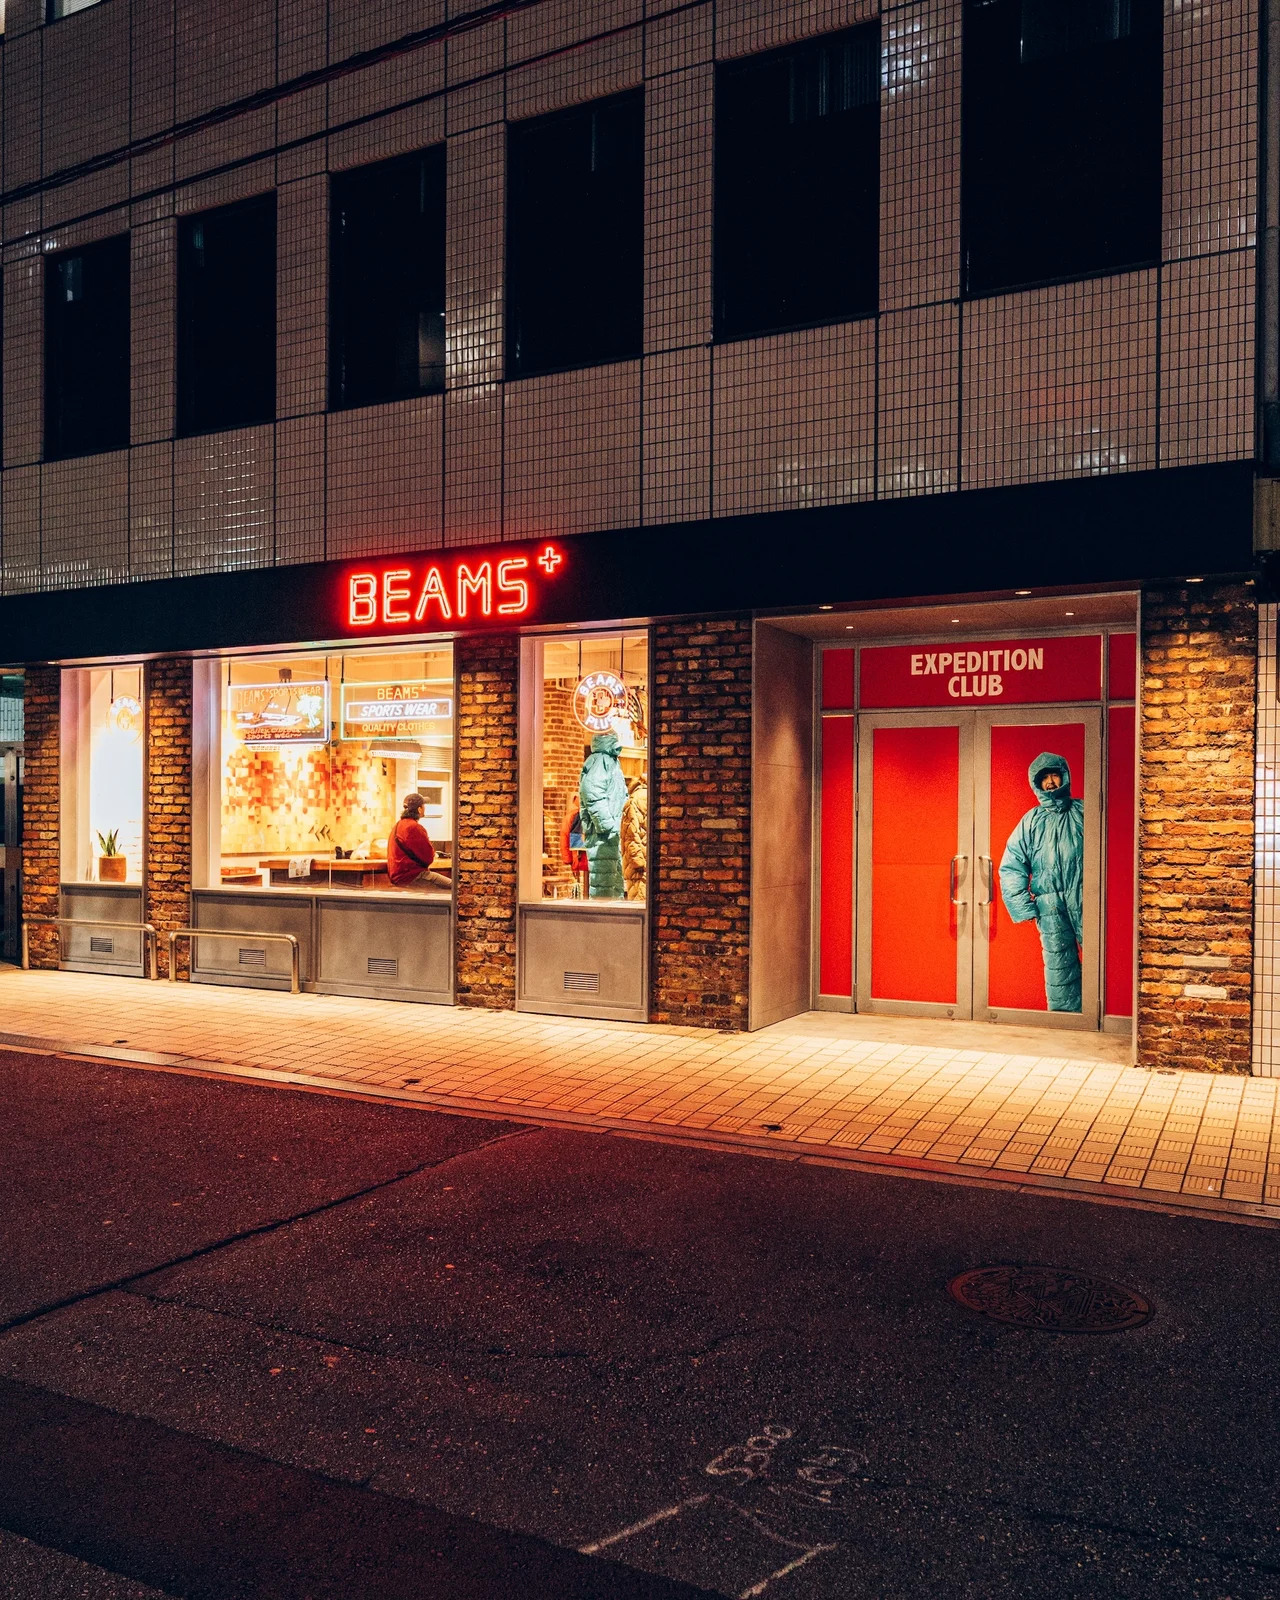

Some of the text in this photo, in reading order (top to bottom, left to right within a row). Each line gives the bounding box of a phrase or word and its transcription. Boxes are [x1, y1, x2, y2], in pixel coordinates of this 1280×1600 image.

[911, 648, 1043, 675] EXPEDITION
[579, 674, 623, 696] BEAMS
[948, 675, 1003, 697] CLUB
[360, 702, 437, 717] SPORTS WEAR
[362, 721, 434, 732] QUALITY CLOTHES
